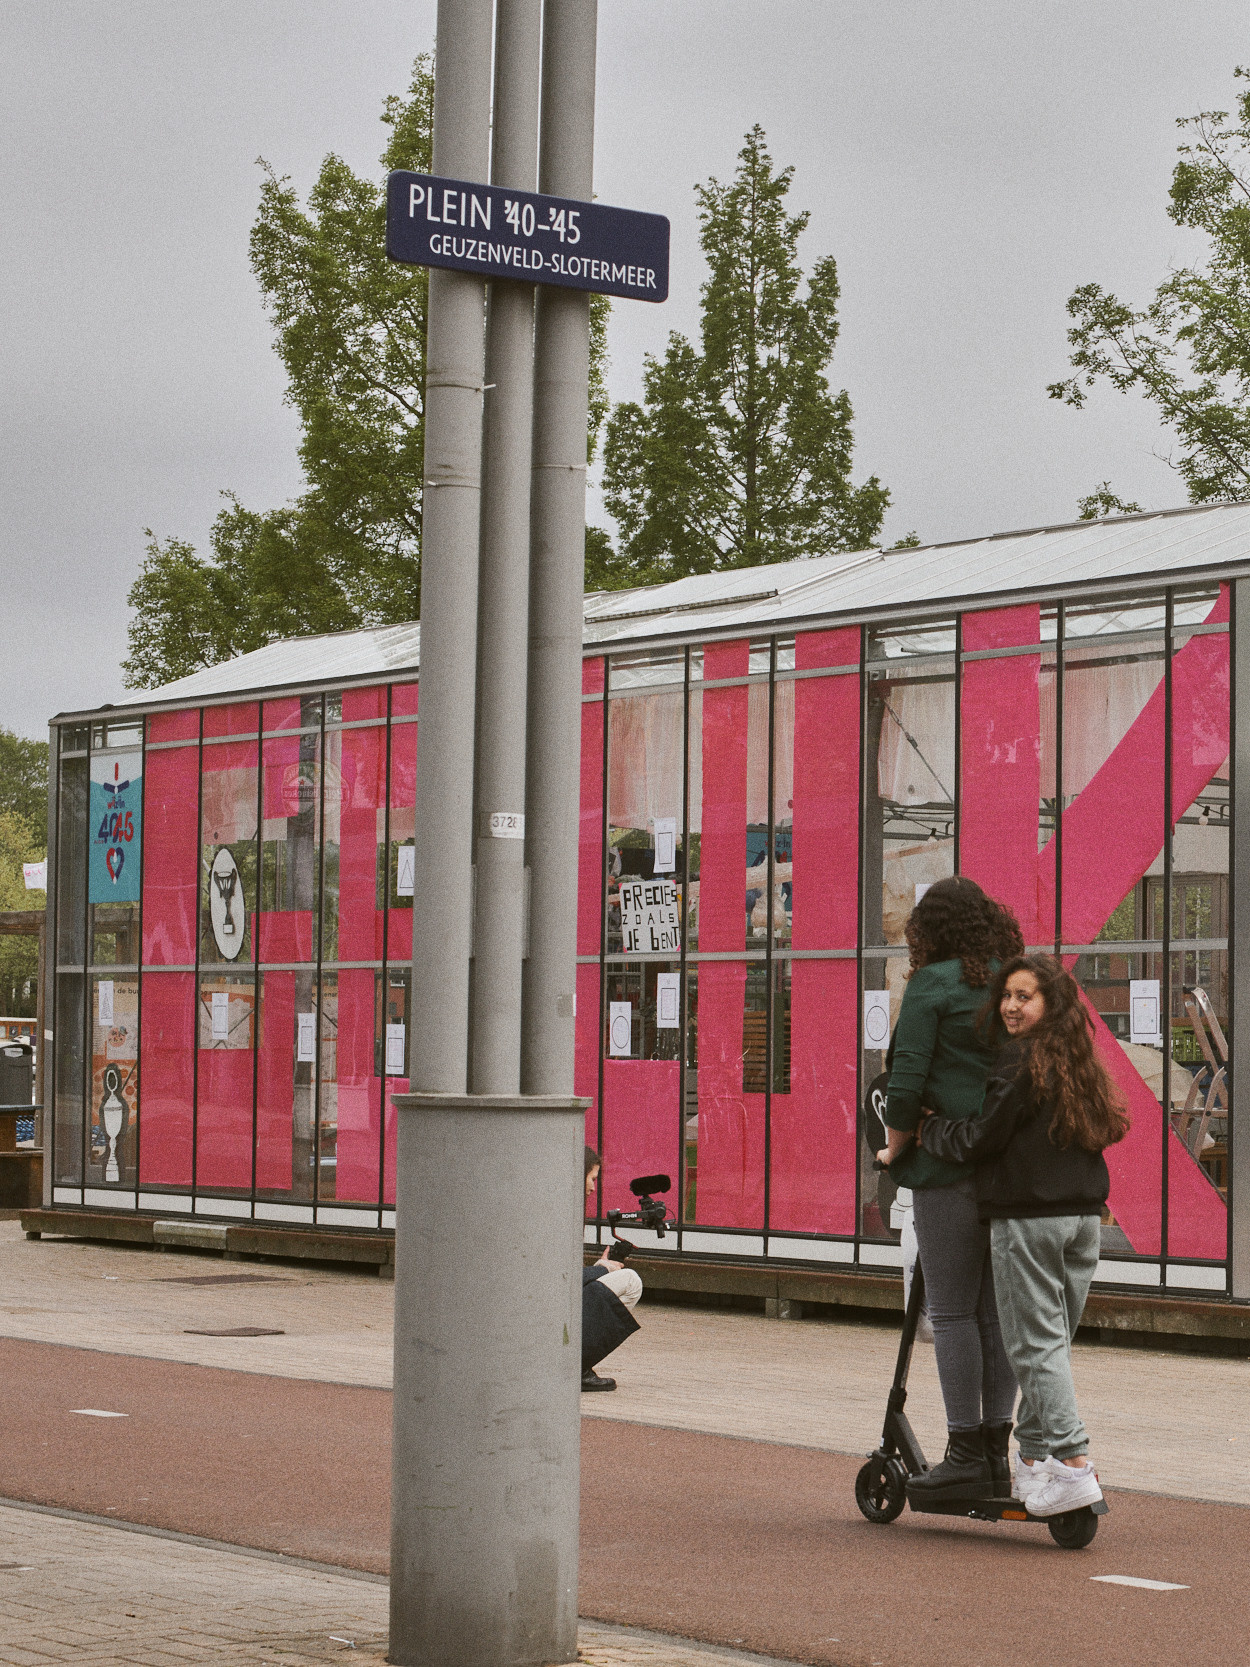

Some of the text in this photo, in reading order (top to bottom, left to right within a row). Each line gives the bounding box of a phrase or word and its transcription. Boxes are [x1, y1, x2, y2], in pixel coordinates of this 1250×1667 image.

[409, 183, 492, 231] PLEIN
[429, 234, 657, 289] GEUZENVELD-SLOTERMEER
[623, 885, 678, 911] PRECIES
[622, 910, 674, 926] ZOALS
[626, 929, 640, 951] JE
